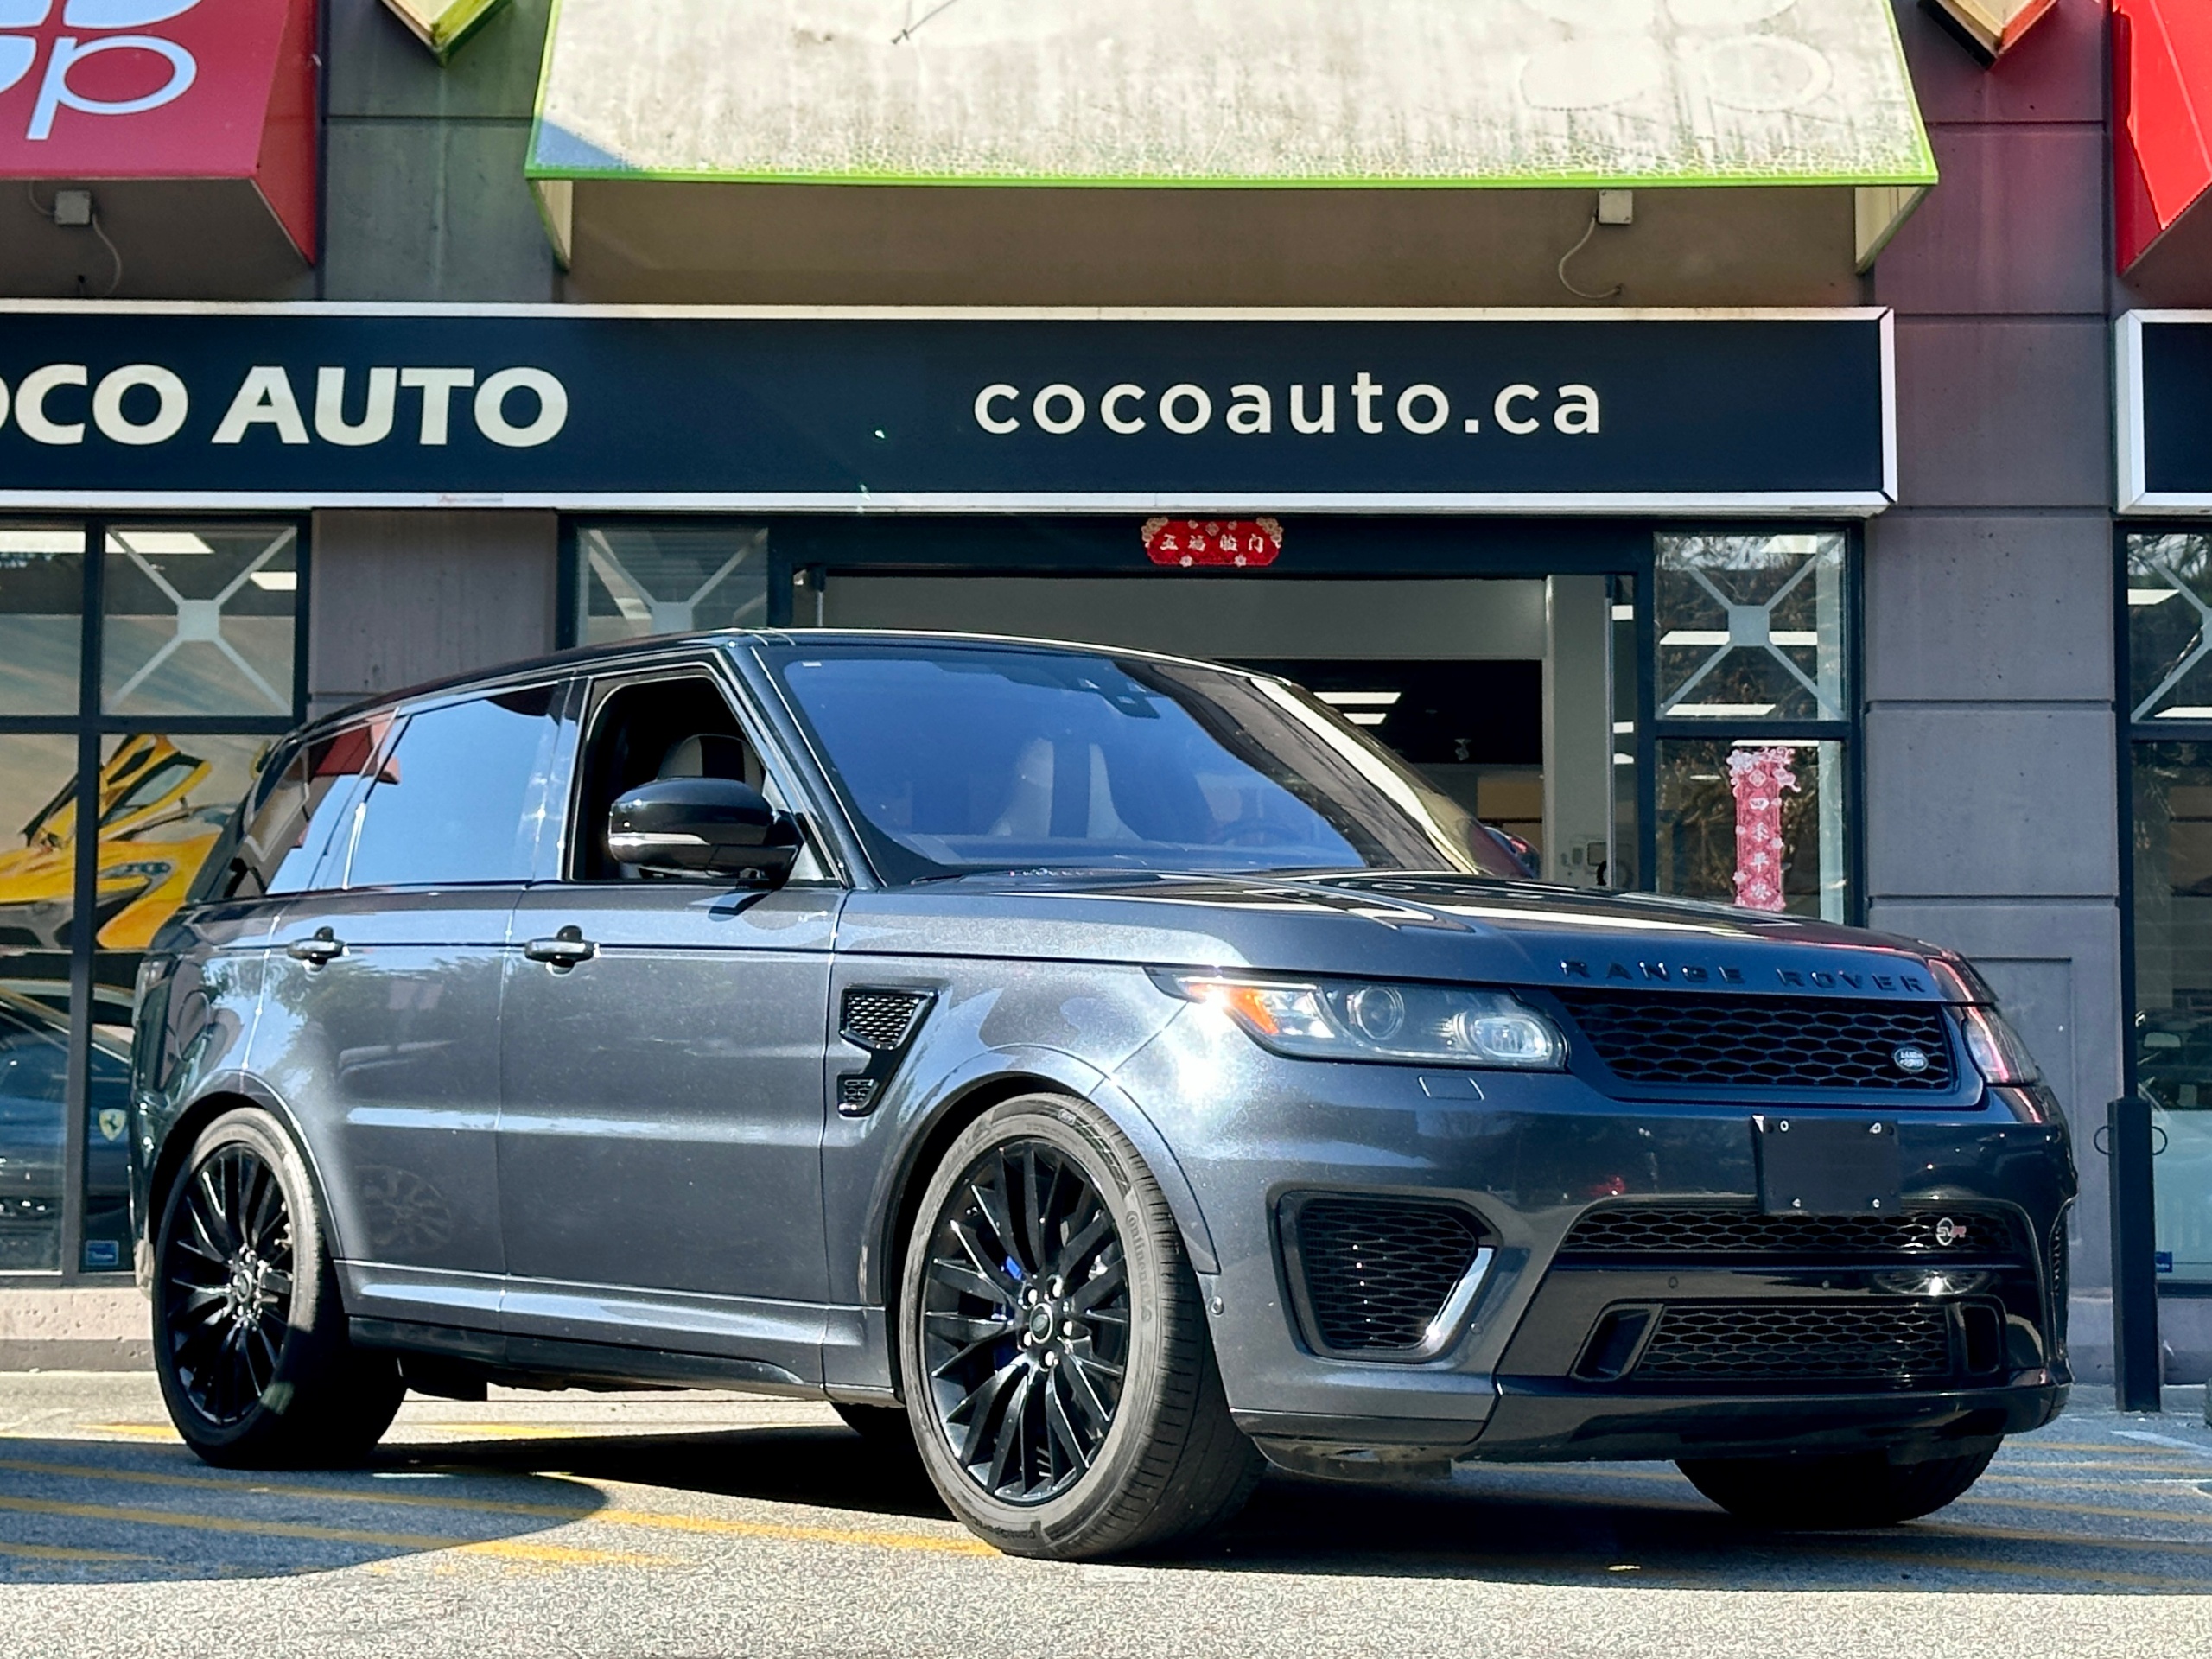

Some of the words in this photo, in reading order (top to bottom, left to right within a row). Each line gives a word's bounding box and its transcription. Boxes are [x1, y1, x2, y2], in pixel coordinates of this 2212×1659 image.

[0, 363, 189, 445] CO
[212, 365, 569, 448] AUTO
[974, 372, 1600, 435] cocoauto.ca
[1160, 533, 1264, 554] 五福临门
[1560, 960, 1745, 984] RANGE
[1776, 968, 1926, 993] ROVER
